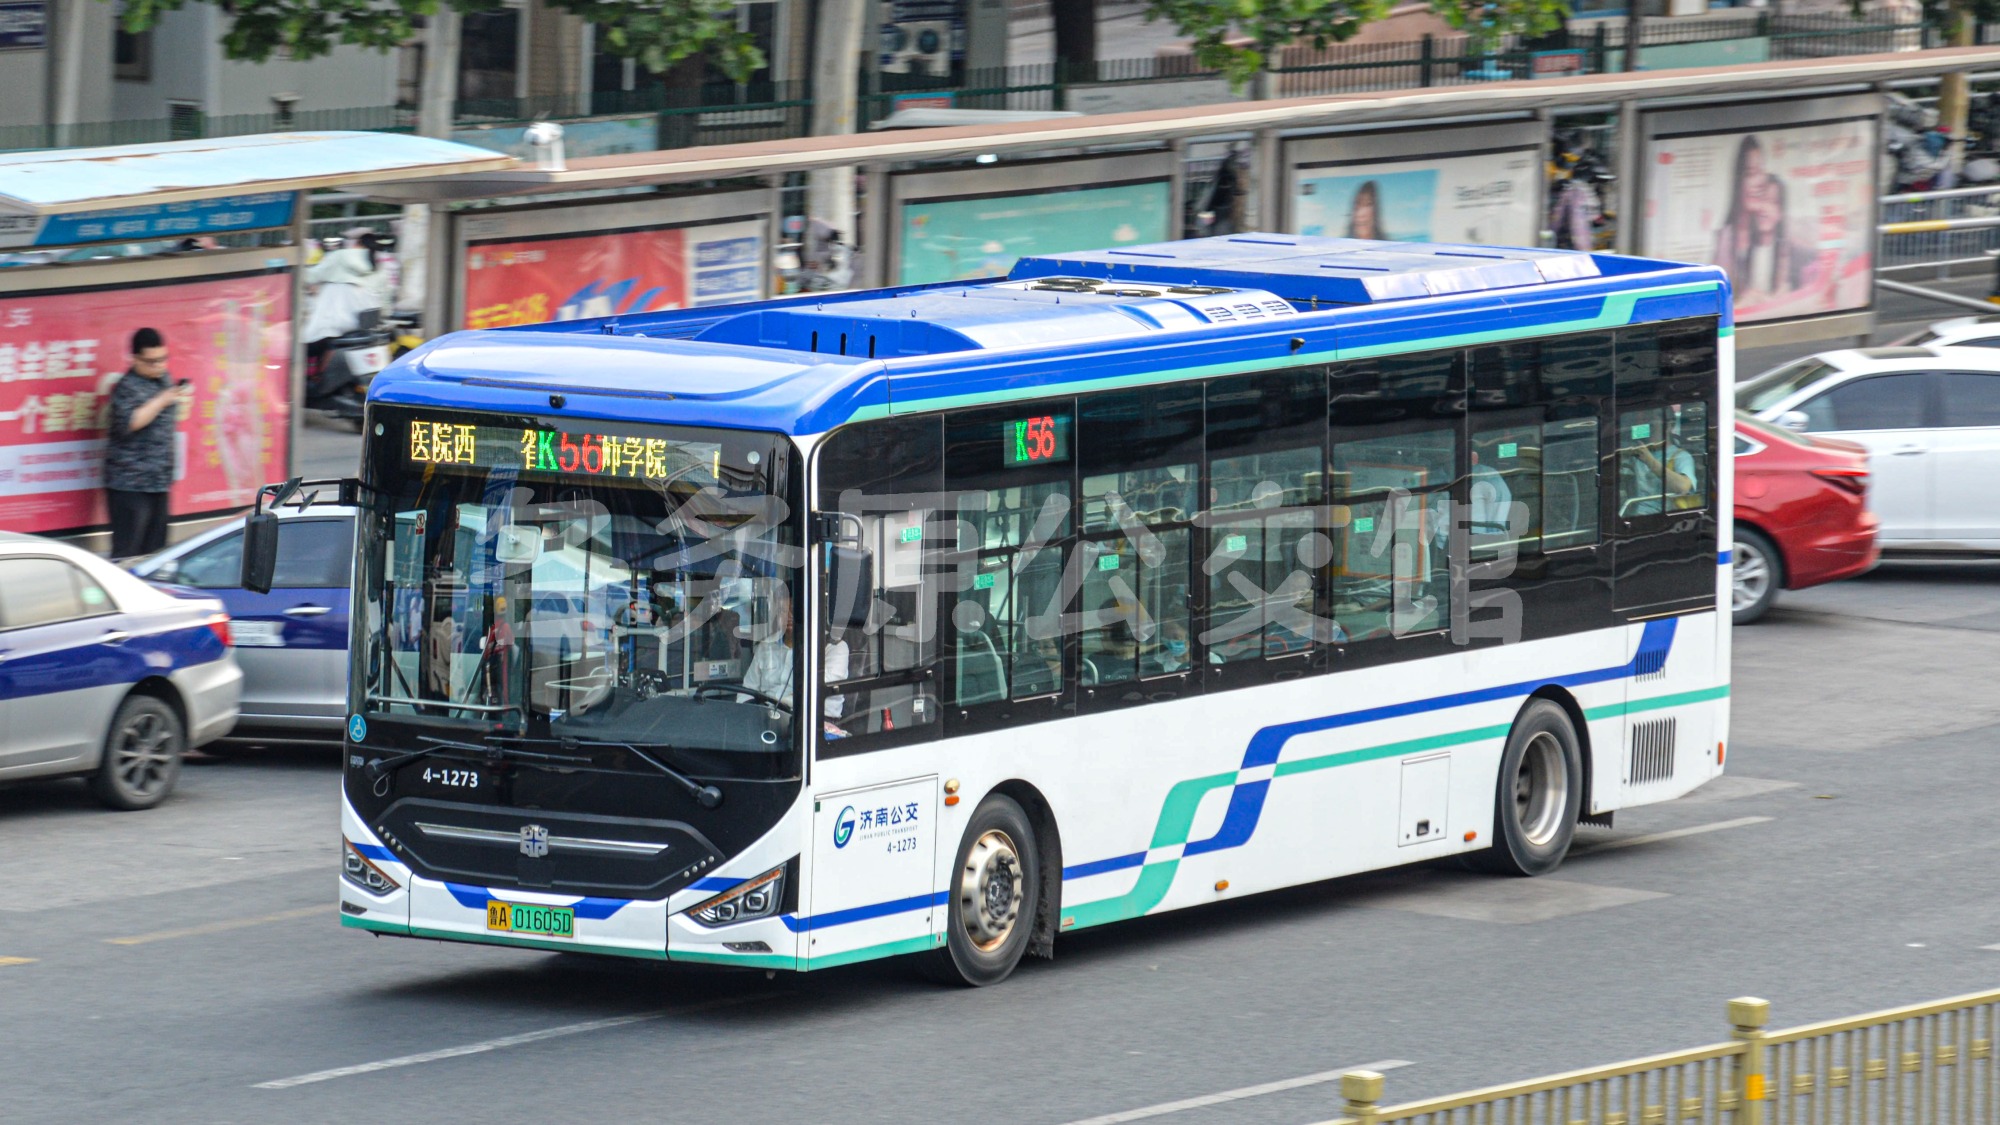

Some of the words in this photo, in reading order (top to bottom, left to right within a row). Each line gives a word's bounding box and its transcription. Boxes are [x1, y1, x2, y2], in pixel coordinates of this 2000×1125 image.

[411, 420, 476, 464] 医院西
[1015, 415, 1056, 461] K56
[422, 767, 478, 788] 4-1273
[860, 802, 918, 830] 济南公交
[887, 837, 917, 854] 4-1273
